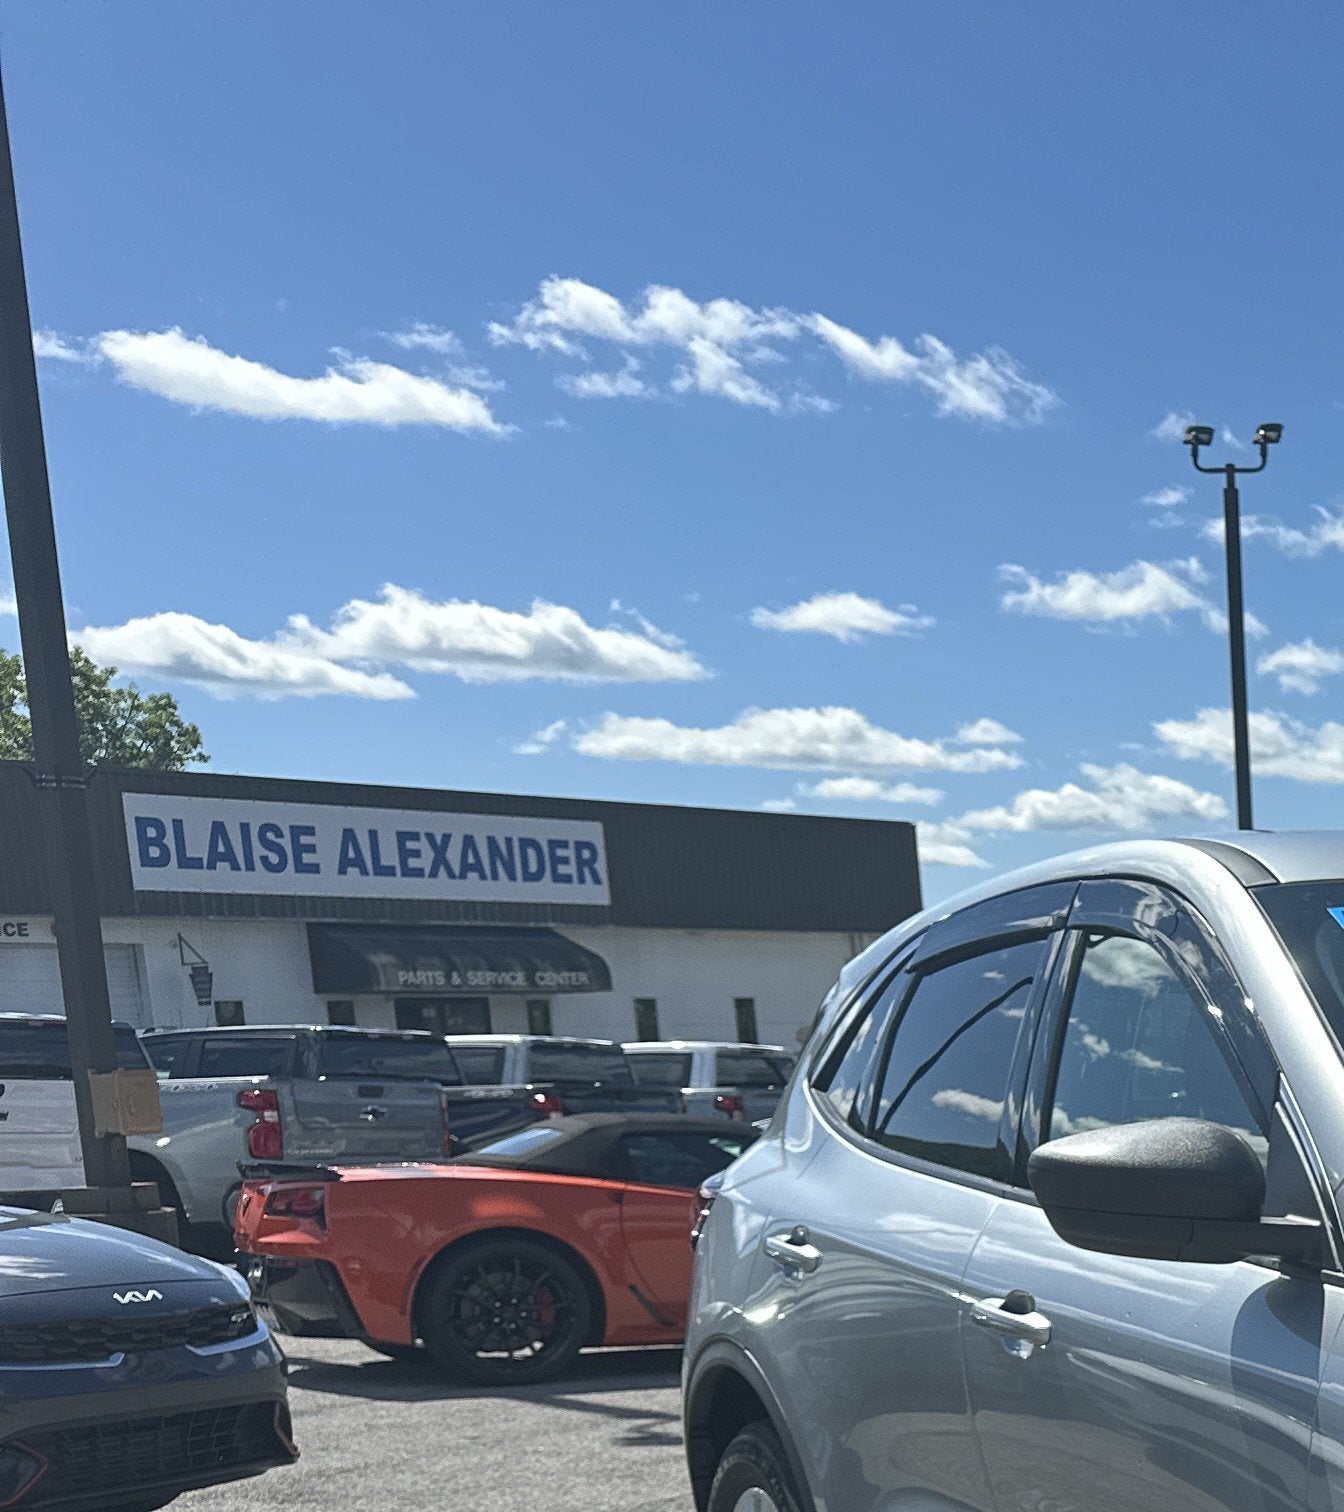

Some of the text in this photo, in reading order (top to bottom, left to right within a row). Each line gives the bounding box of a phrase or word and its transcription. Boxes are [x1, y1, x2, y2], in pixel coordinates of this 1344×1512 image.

[134, 816, 603, 886] BLAISE ALEXANDER
[398, 970, 590, 986] PARTS & SERVICE CENTER
